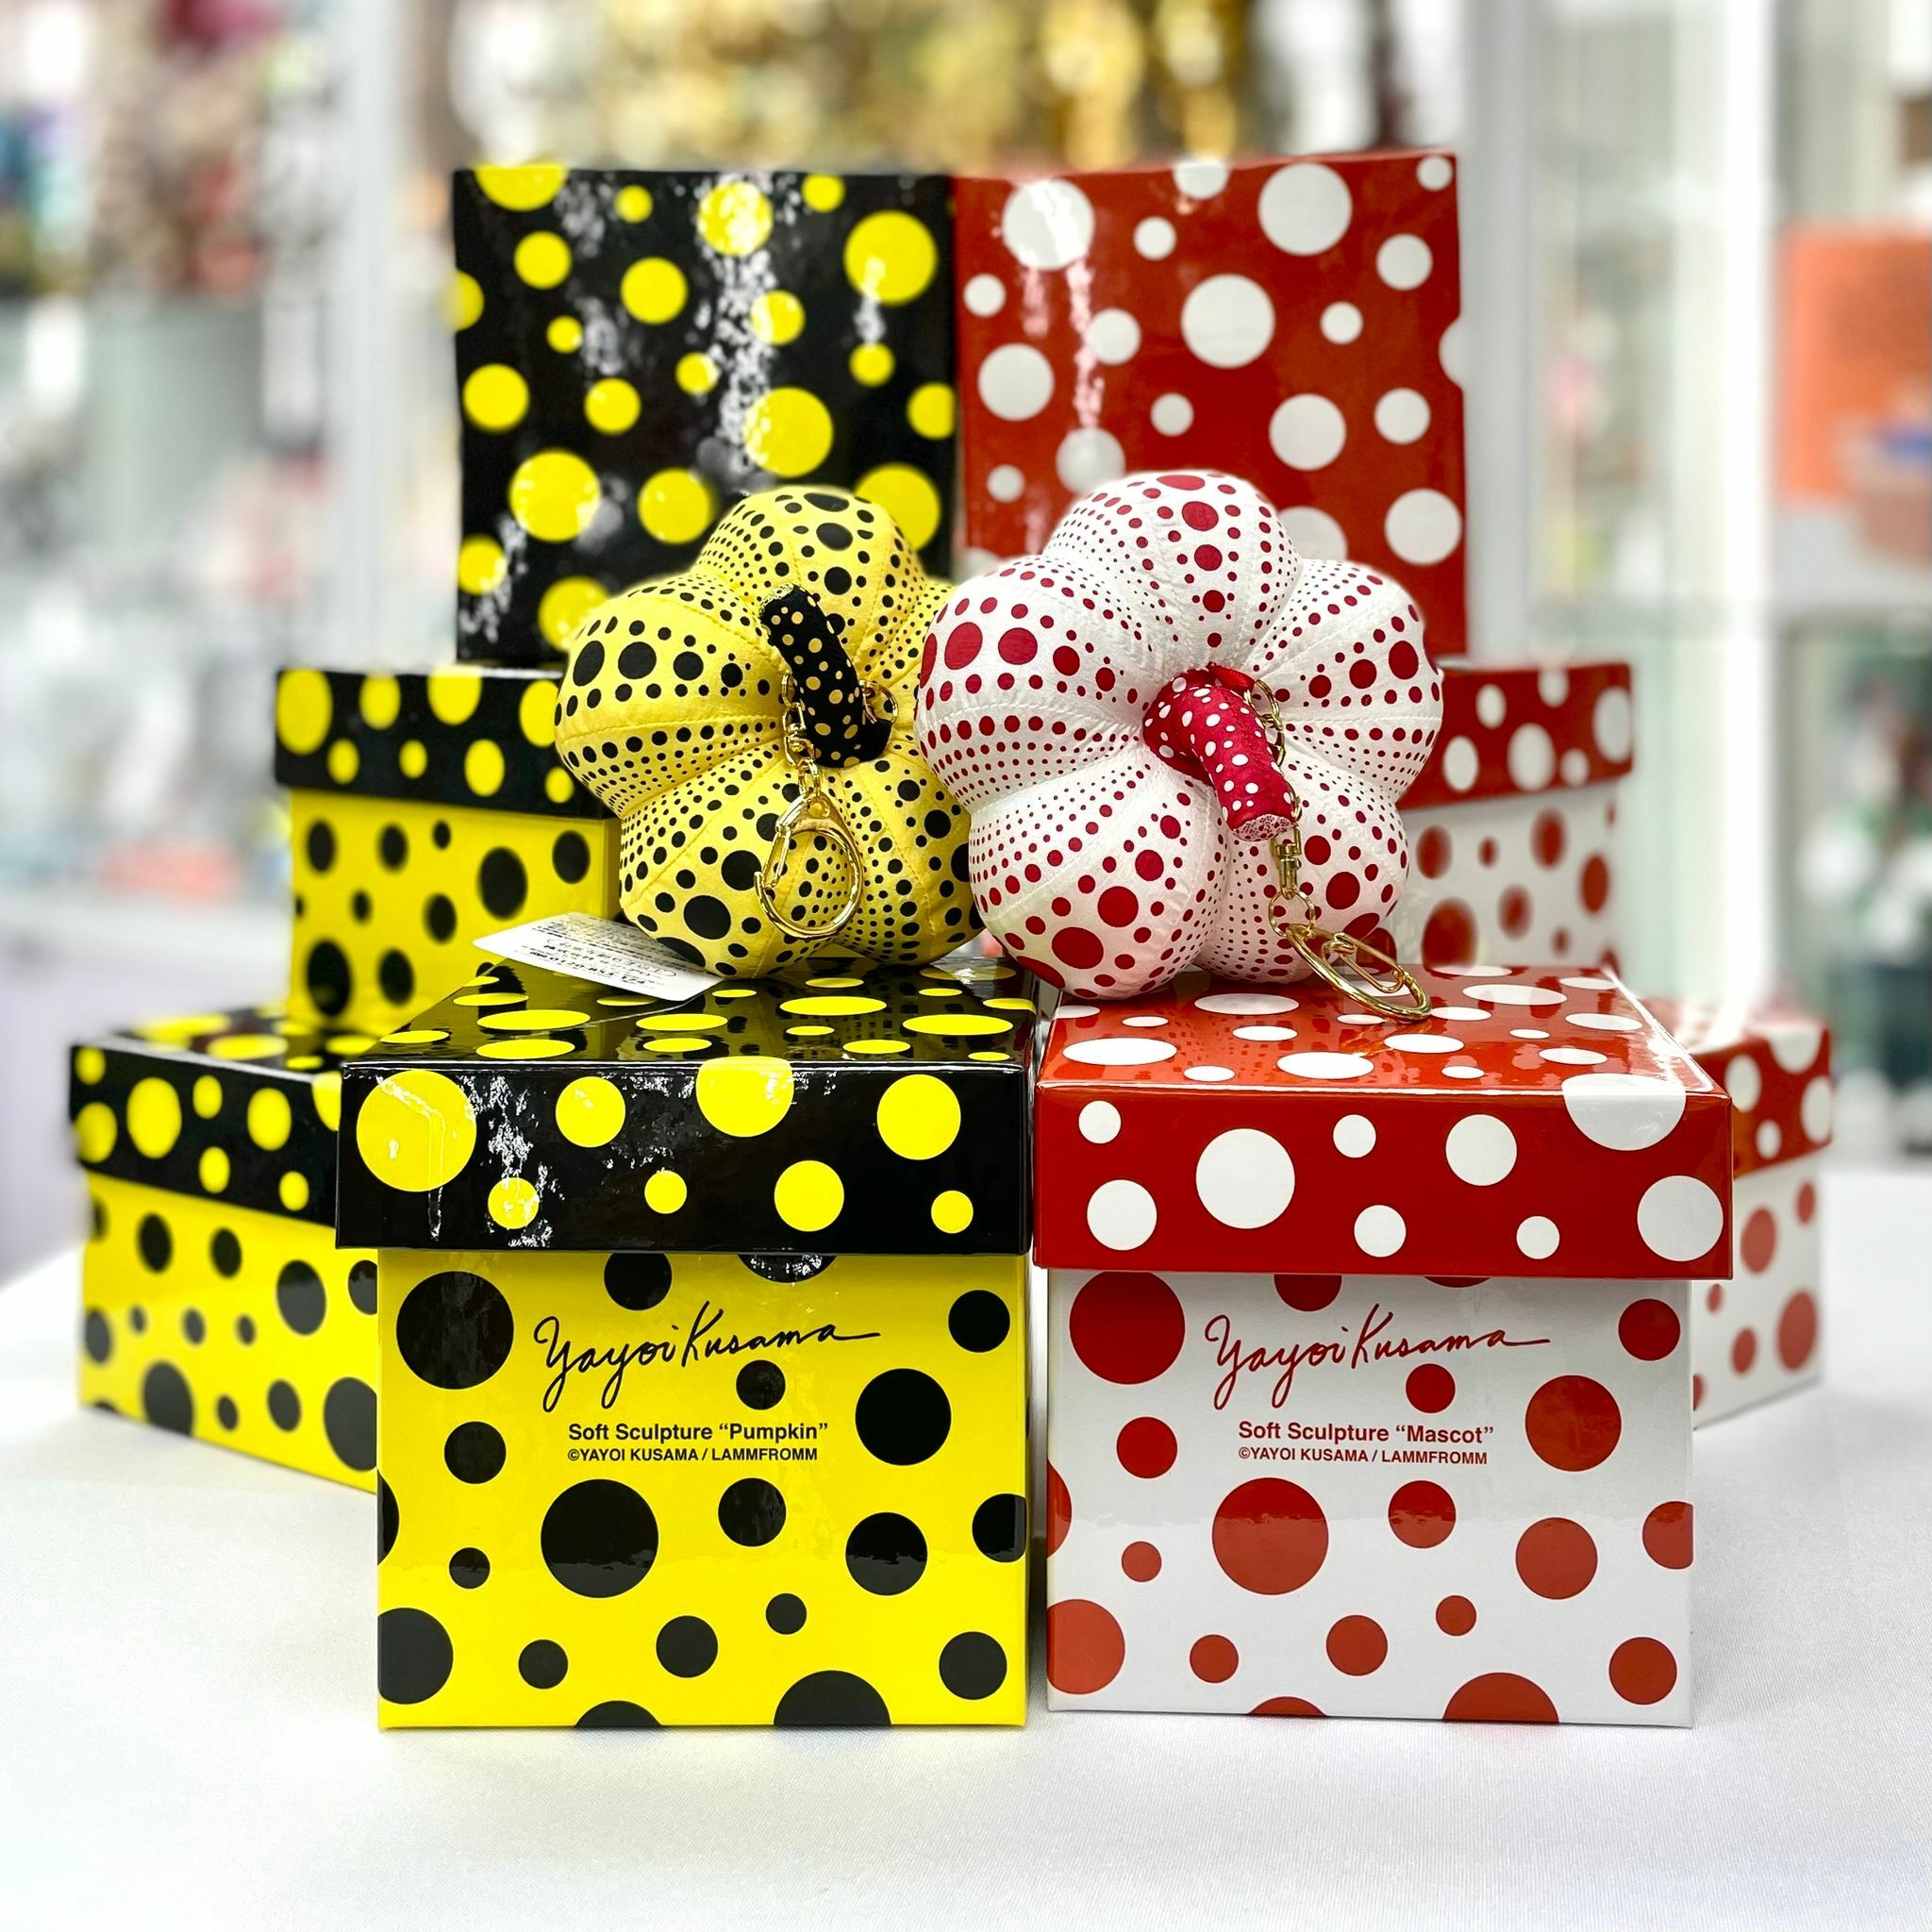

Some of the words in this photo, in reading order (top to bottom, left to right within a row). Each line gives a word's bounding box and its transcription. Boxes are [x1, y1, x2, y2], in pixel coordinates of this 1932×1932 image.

[534, 1315, 679, 1412] Yayoi
[681, 1300, 881, 1368] Kusama
[1205, 1314, 1349, 1410] Yayoi
[1351, 1303, 1551, 1370] Kusama
[569, 1424, 608, 1441] Soft
[616, 1424, 712, 1444] Sculpture
[720, 1423, 827, 1443] “Pumpkin”
[1239, 1421, 1281, 1439] Soft
[1288, 1423, 1389, 1444] Sculpture
[1396, 1425, 1493, 1443] “Mascot”
[568, 1448, 625, 1461] ©YAYOI
[631, 1448, 698, 1461] KUSAMA
[712, 1448, 817, 1460] LAMMFROMM
[1239, 1447, 1295, 1460] ©YAYOI
[1301, 1448, 1368, 1461] KUSAMA
[1382, 1450, 1487, 1464] LAMMFROMM
